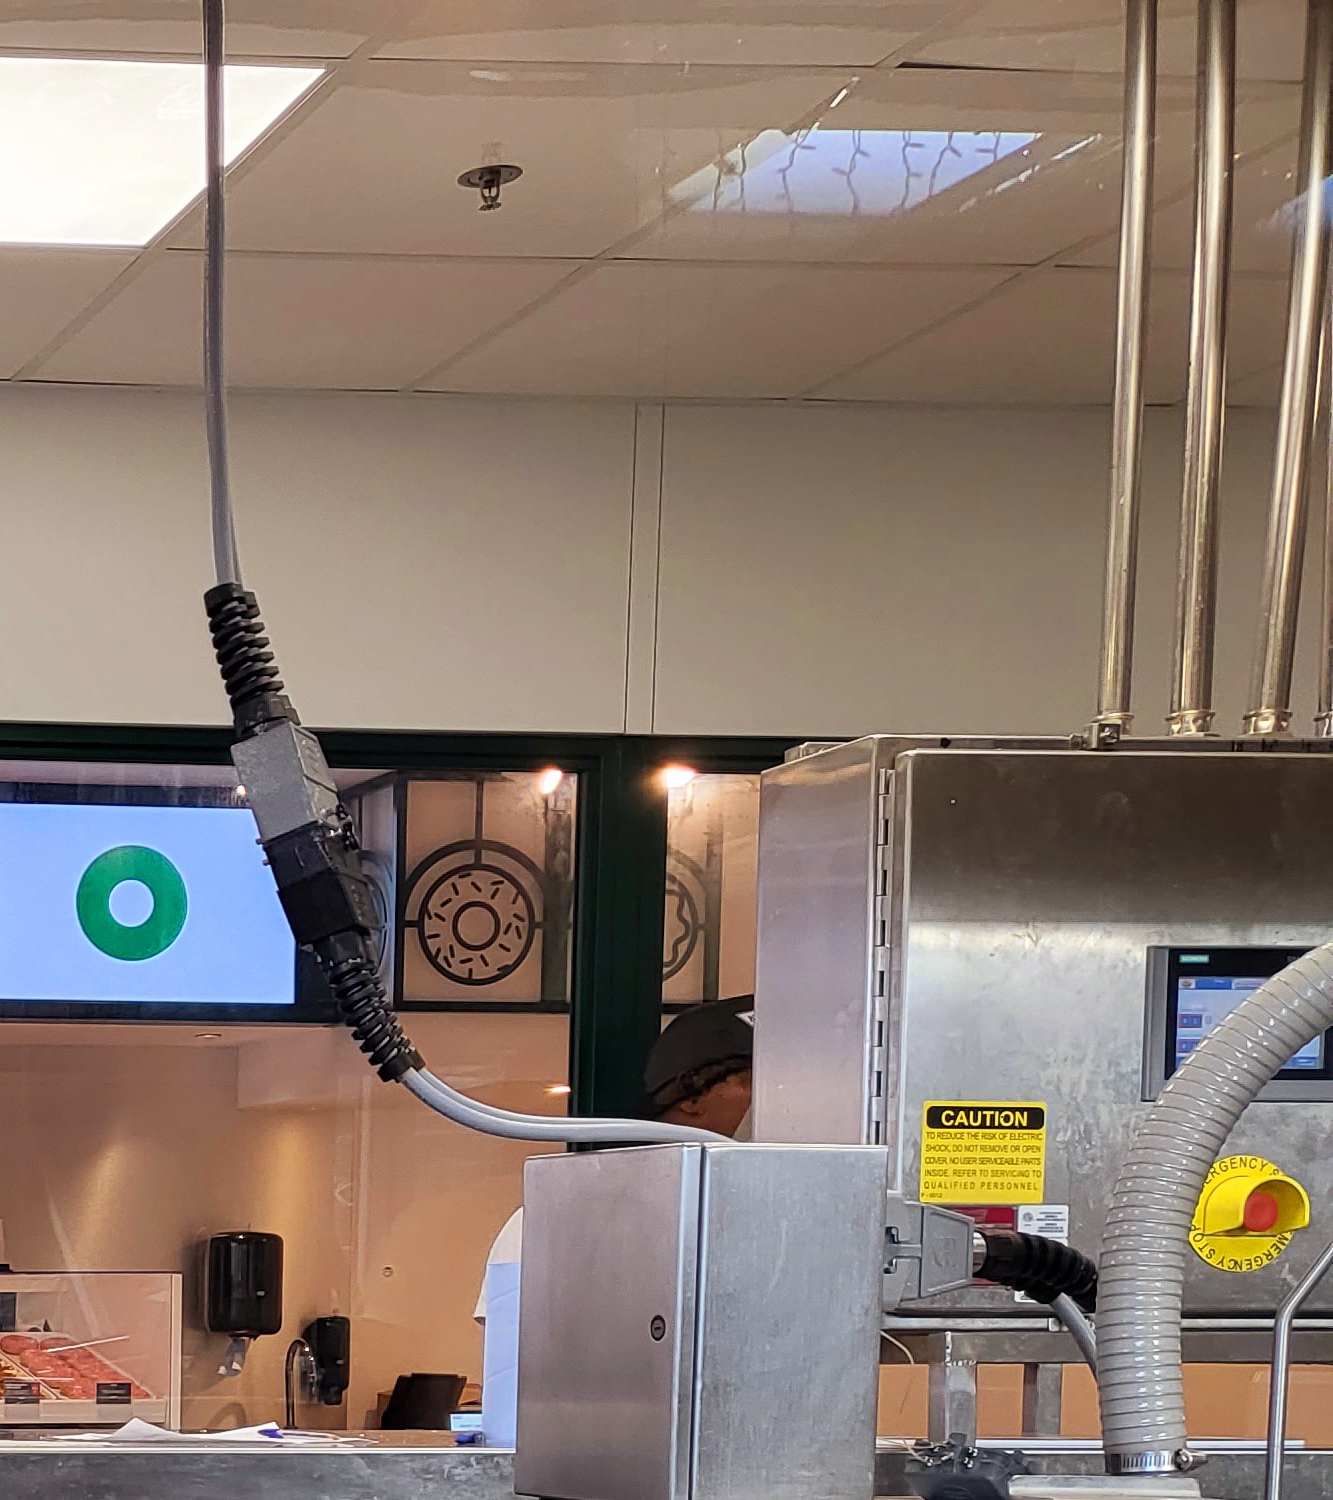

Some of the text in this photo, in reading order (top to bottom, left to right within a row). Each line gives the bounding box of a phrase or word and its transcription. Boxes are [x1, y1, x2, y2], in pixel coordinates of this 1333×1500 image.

[941, 1110, 1028, 1126] CAUTION
[926, 1132, 935, 1140] TO
[937, 1132, 965, 1140] REDUCE
[952, 1144, 962, 1152] DO
[979, 1145, 1008, 1153] REMOVE
[1010, 1145, 1020, 1153] OR
[1021, 1145, 1041, 1153] OPEN
[978, 1157, 1020, 1165] SERVICEABLE
[953, 1169, 977, 1177] REFER
[980, 1169, 989, 1177] TO
[1032, 1170, 1042, 1178] TO
[1206, 1157, 1268, 1185] RGENCY
[924, 1181, 1038, 1190] QUALIFIED PERSONNEL
[1216, 1231, 1293, 1271] MERGENCY
